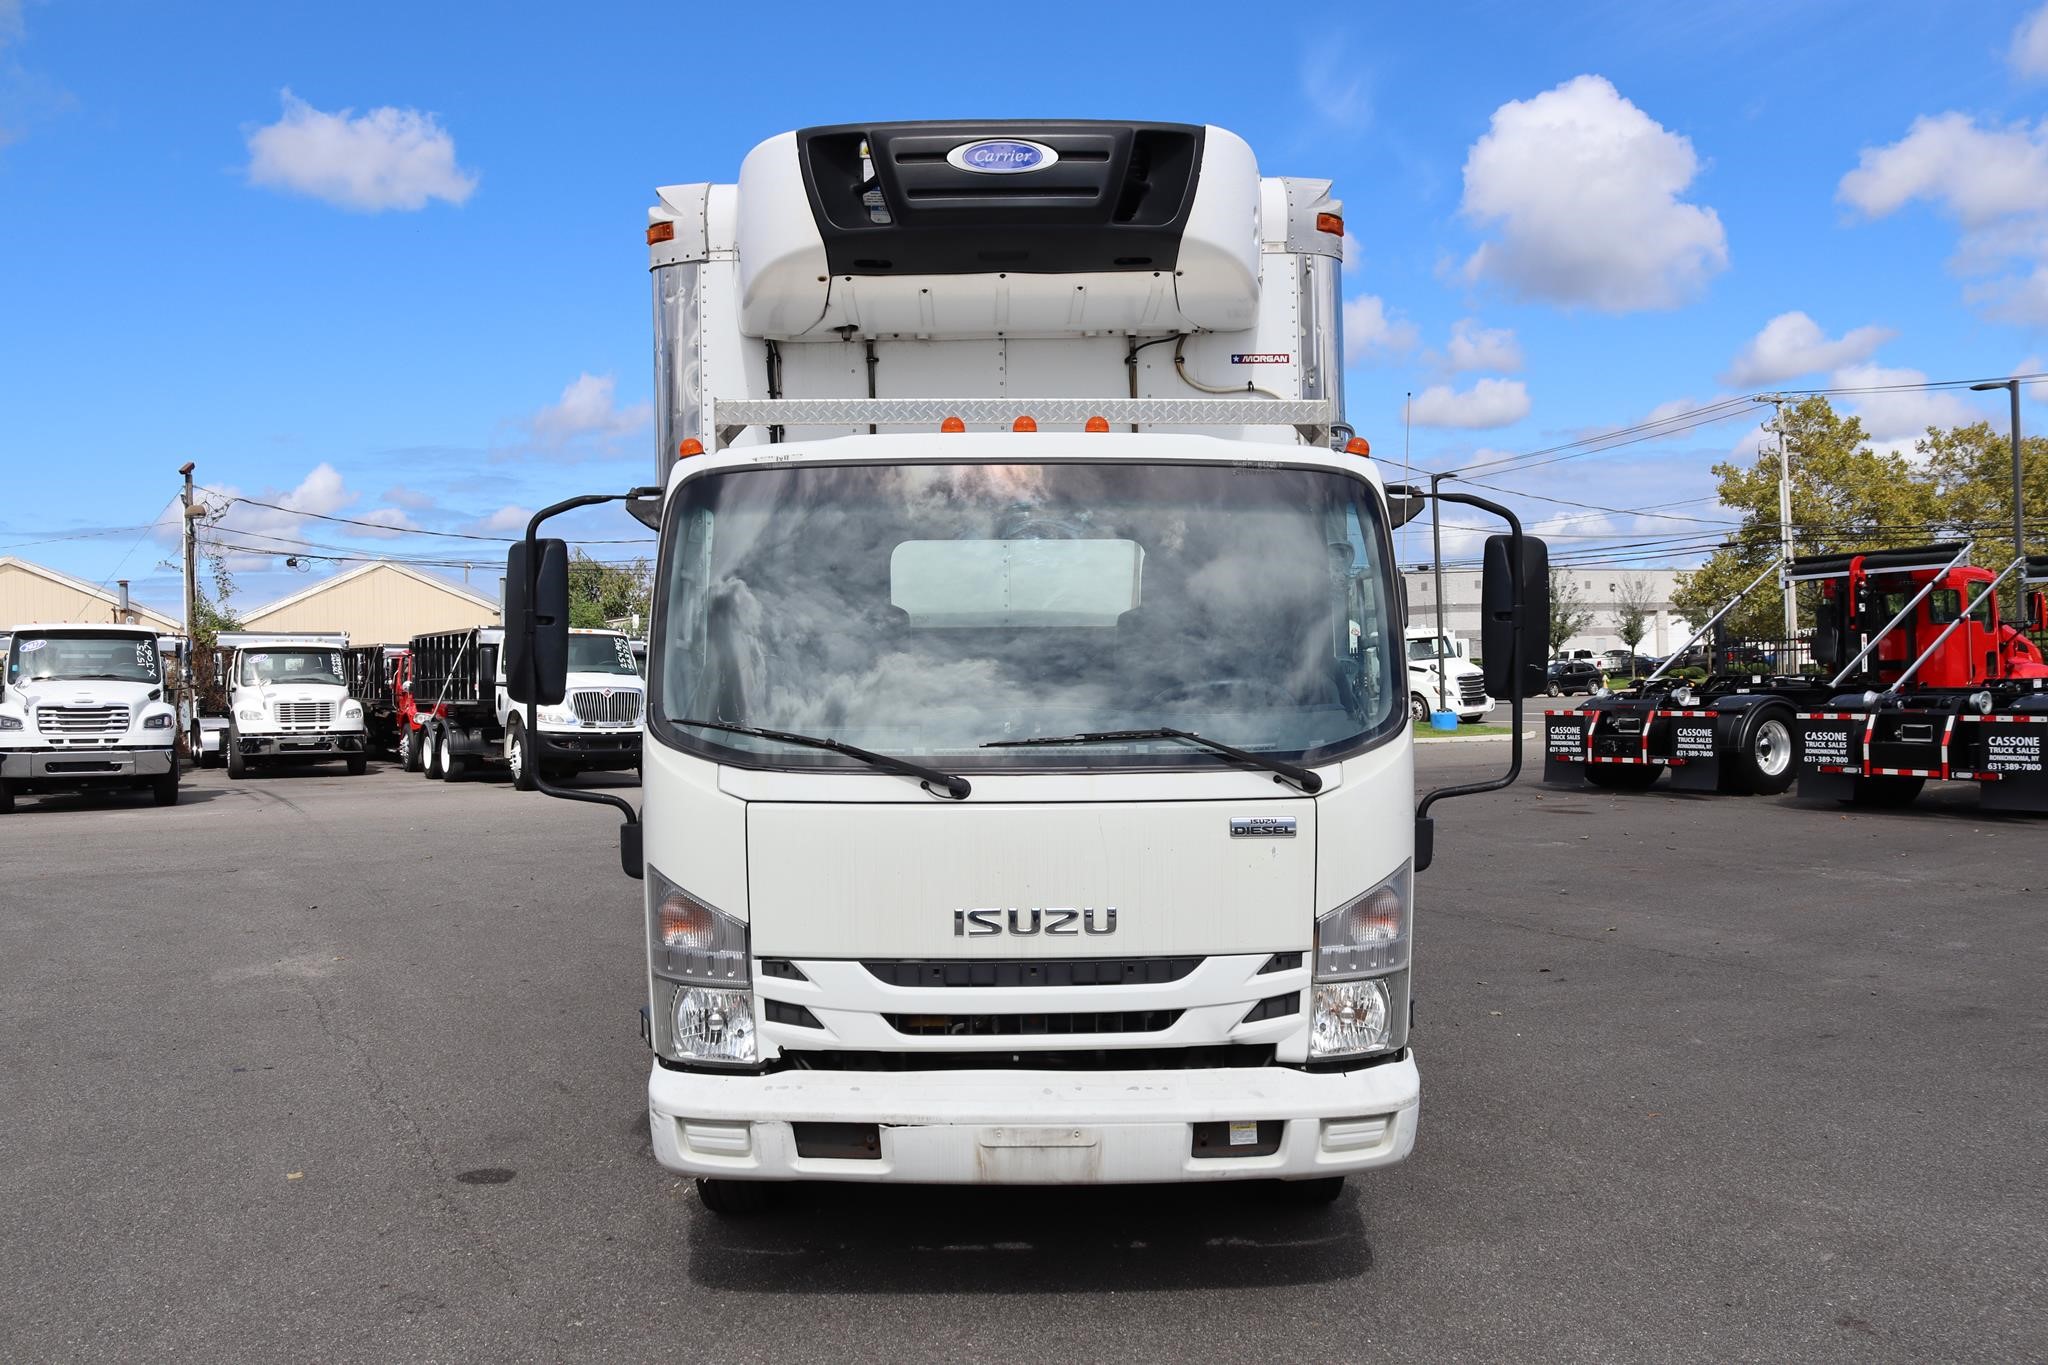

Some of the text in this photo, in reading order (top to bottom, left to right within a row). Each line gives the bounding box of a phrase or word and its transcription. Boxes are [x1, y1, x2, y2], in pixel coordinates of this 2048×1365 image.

[974, 149, 1032, 162] Carrier
[1242, 355, 1288, 363] MORGAN
[136, 645, 145, 666] 1575
[1550, 726, 1580, 734] CASSONE
[1677, 728, 1712, 737] CASSONE
[1804, 732, 1847, 741] CASSONE
[1988, 736, 2040, 746] CASSONE
[1234, 826, 1294, 835] DIESEL
[954, 907, 1117, 937] ISUZU
